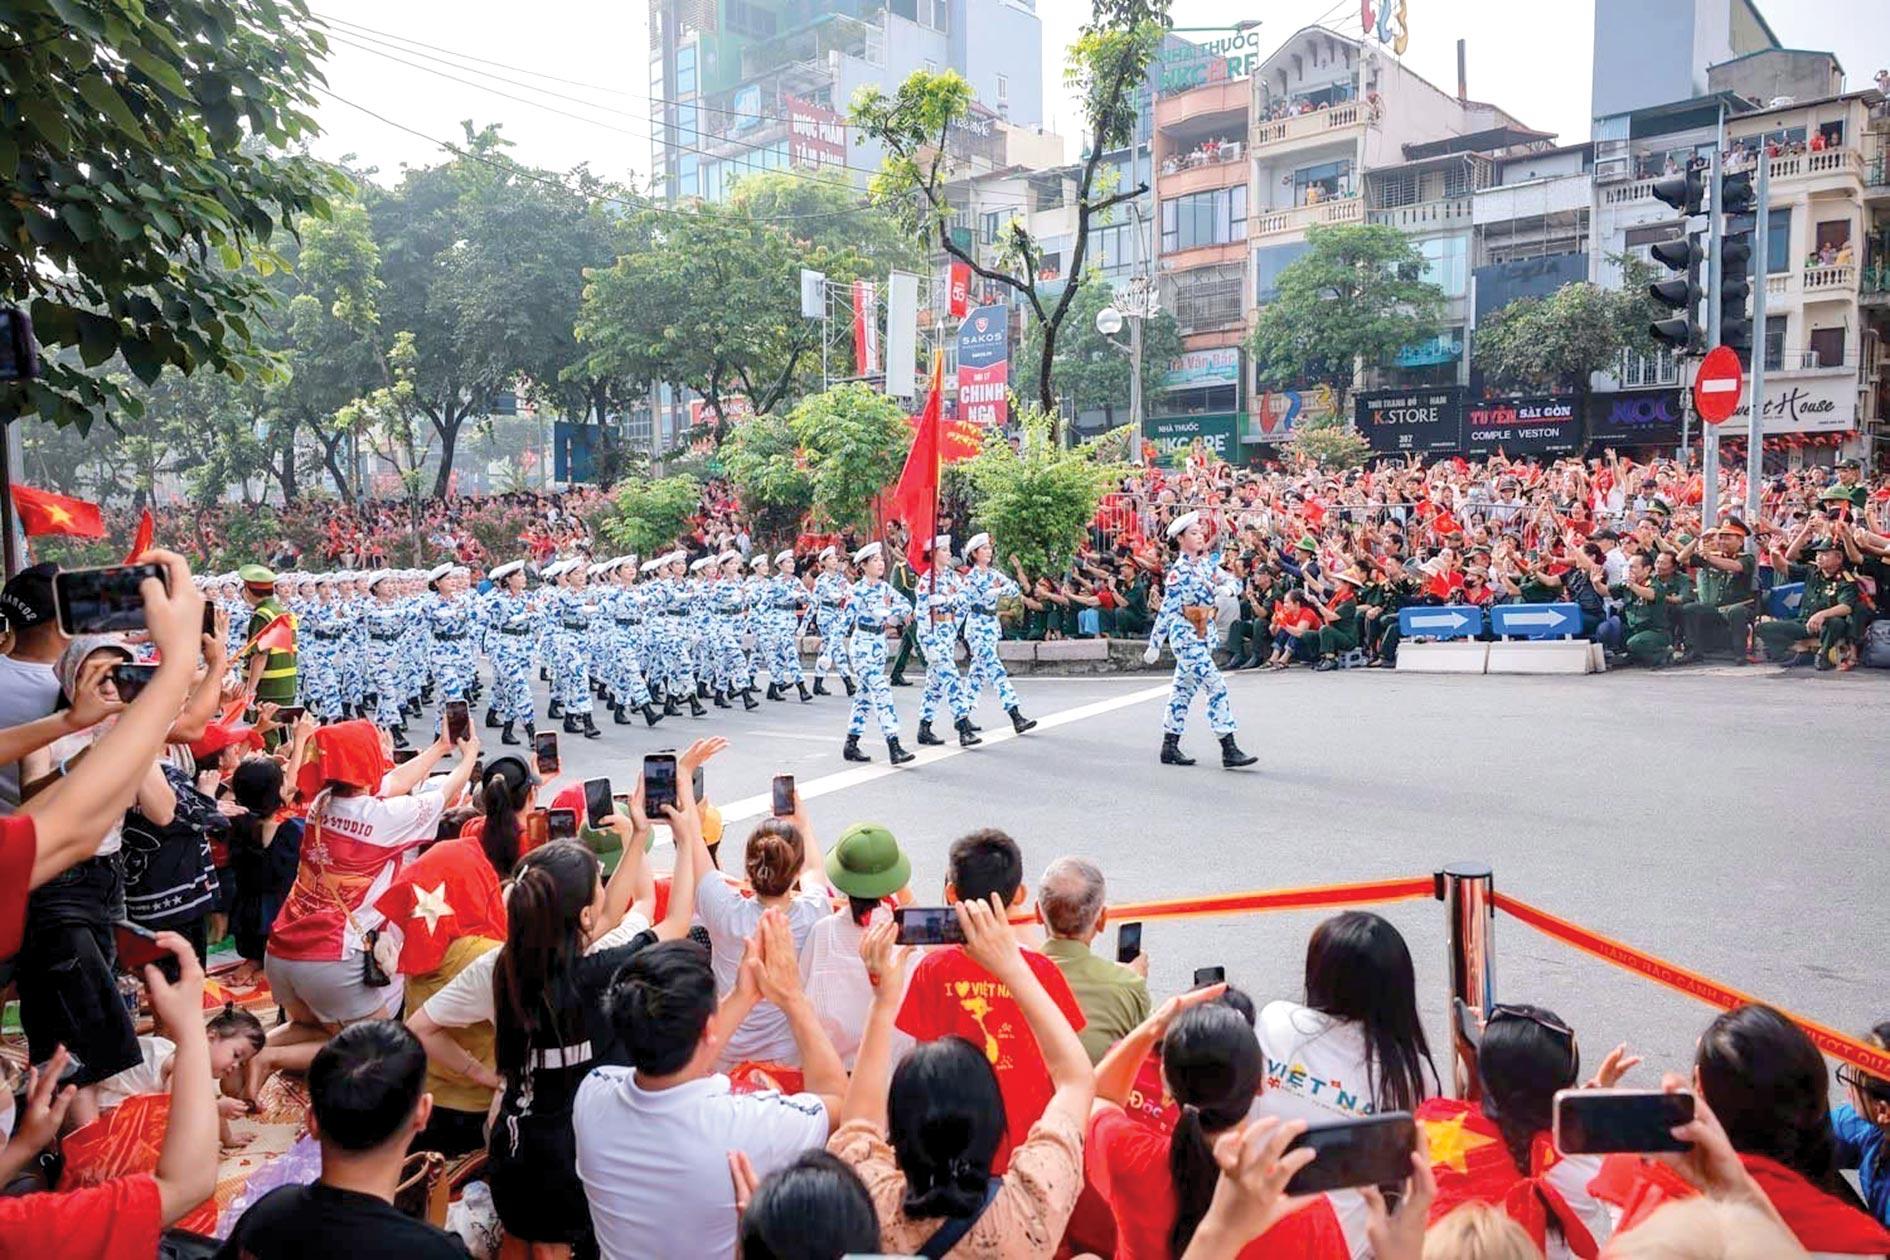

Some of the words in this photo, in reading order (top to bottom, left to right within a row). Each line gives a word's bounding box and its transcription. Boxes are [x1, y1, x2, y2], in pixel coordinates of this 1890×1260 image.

[962, 332, 1002, 345] SAKOS
[1519, 406, 1542, 418] SÀI
[1544, 404, 1572, 417] GÒN
[1774, 387, 1836, 421] House
[968, 404, 996, 423] NGA
[1471, 430, 1511, 440] COMPLE
[1518, 428, 1560, 438] VESTON
[331, 816, 374, 837] STUDIO
[944, 983, 953, 997] I
[997, 983, 1014, 999] NA
